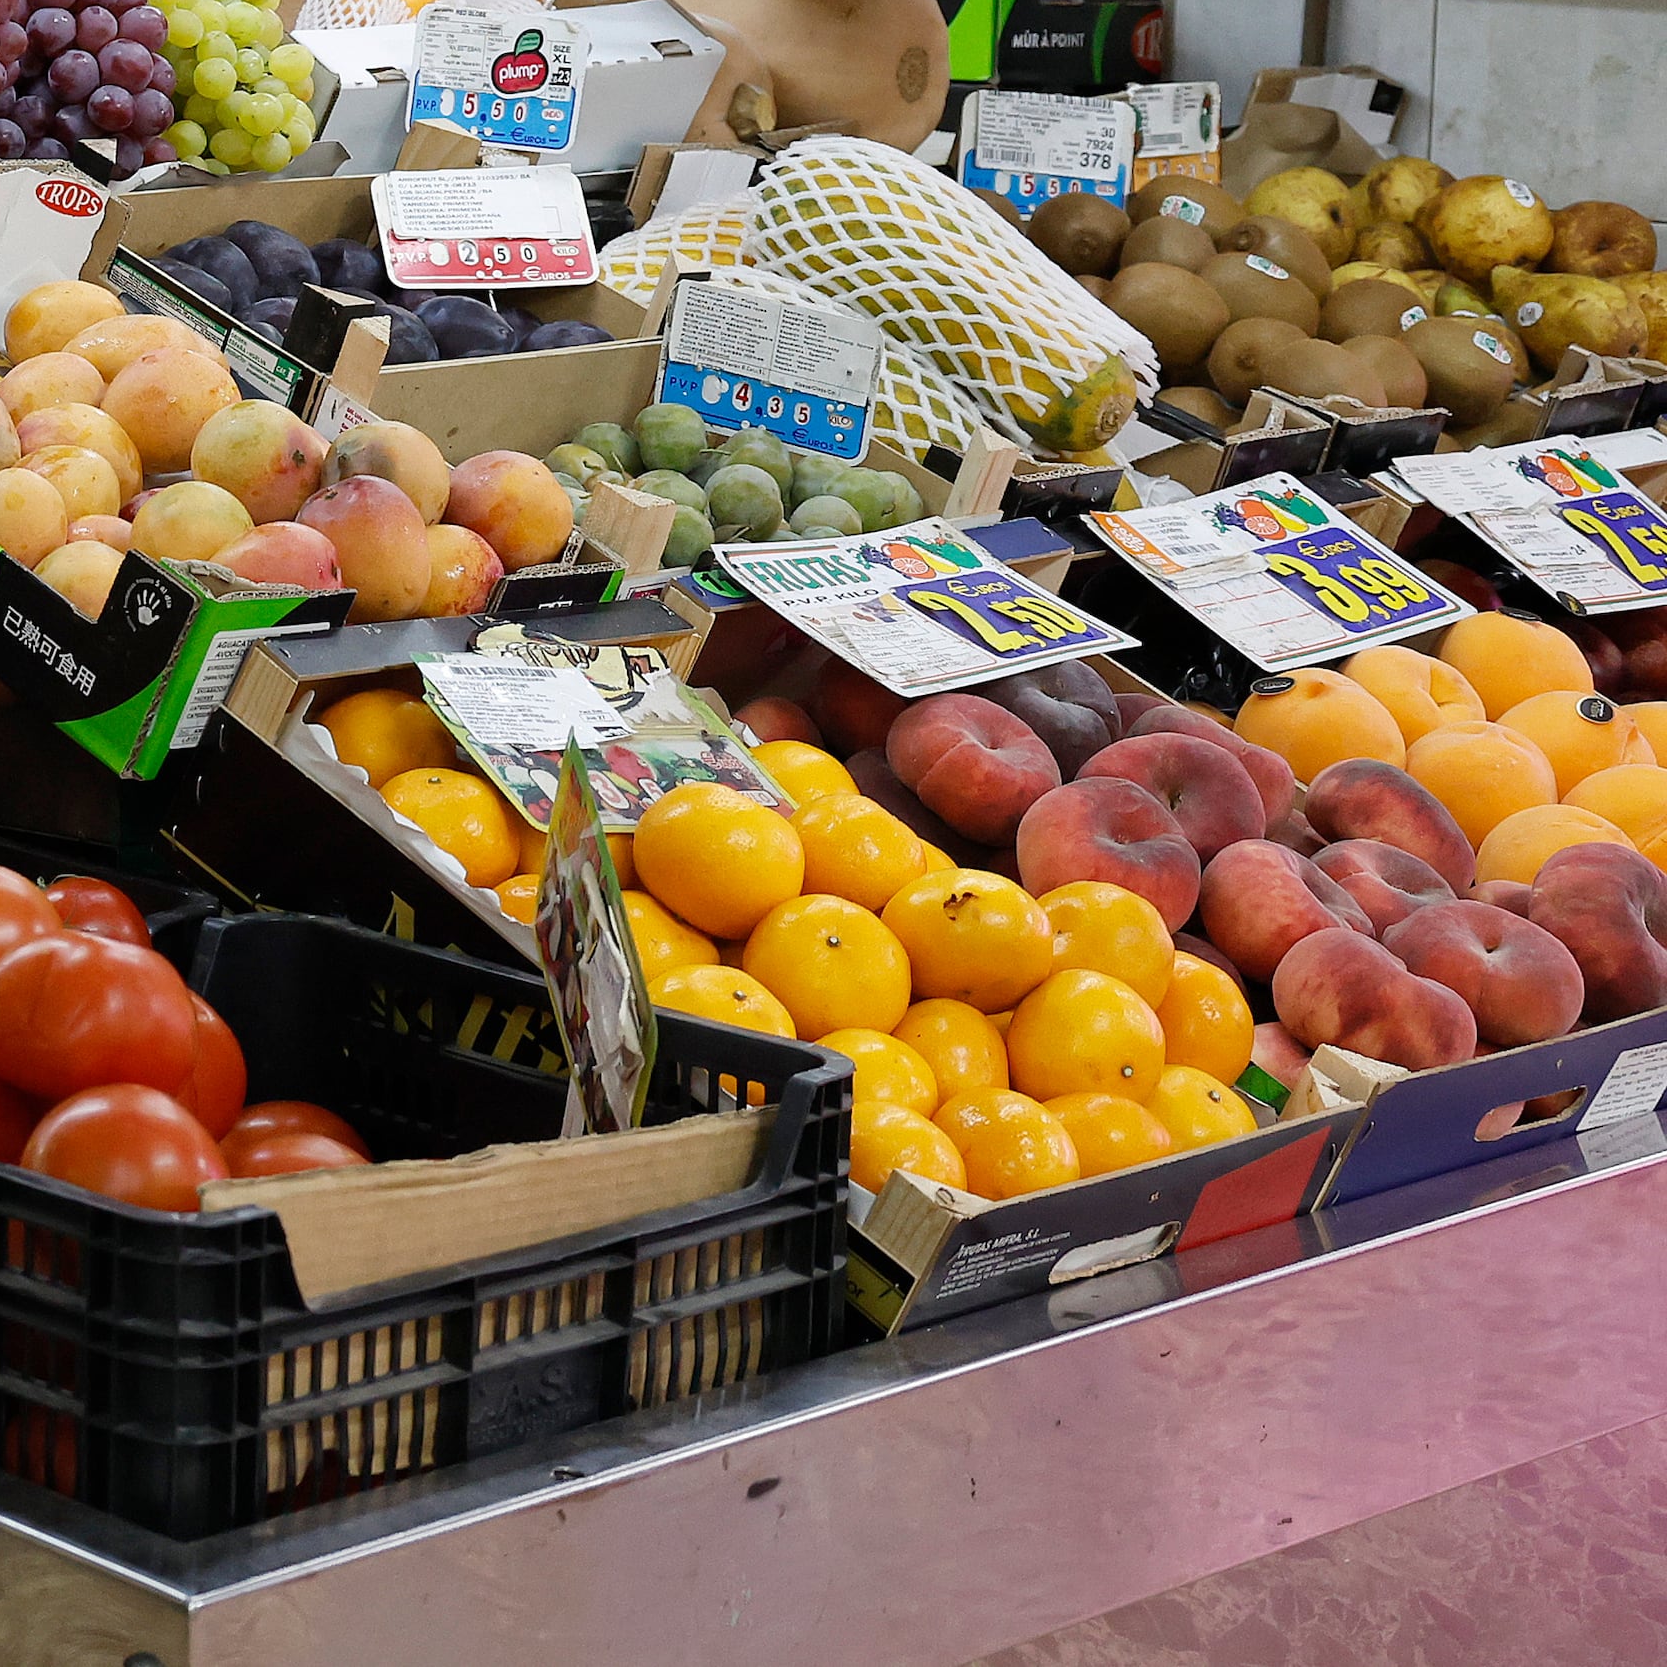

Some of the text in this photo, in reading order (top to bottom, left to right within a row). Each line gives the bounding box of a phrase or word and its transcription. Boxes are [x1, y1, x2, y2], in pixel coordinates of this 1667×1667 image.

[1051, 33, 1085, 48] POINT
[553, 45, 571, 53] SIZE
[553, 55, 571, 63] XL
[499, 63, 539, 83] plump
[415, 98, 436, 109] P.V.P.
[1101, 127, 1115, 138] 30
[1085, 138, 1114, 150] 7924
[1080, 152, 1111, 169] 378
[38, 181, 103, 214] TROPS
[742, 554, 869, 594] FRUTAS
[837, 588, 878, 602] KILO
[1265, 553, 1433, 622] 3,99
[906, 589, 1088, 654] 2,50
[2, 605, 97, 697] 已熟可食用
